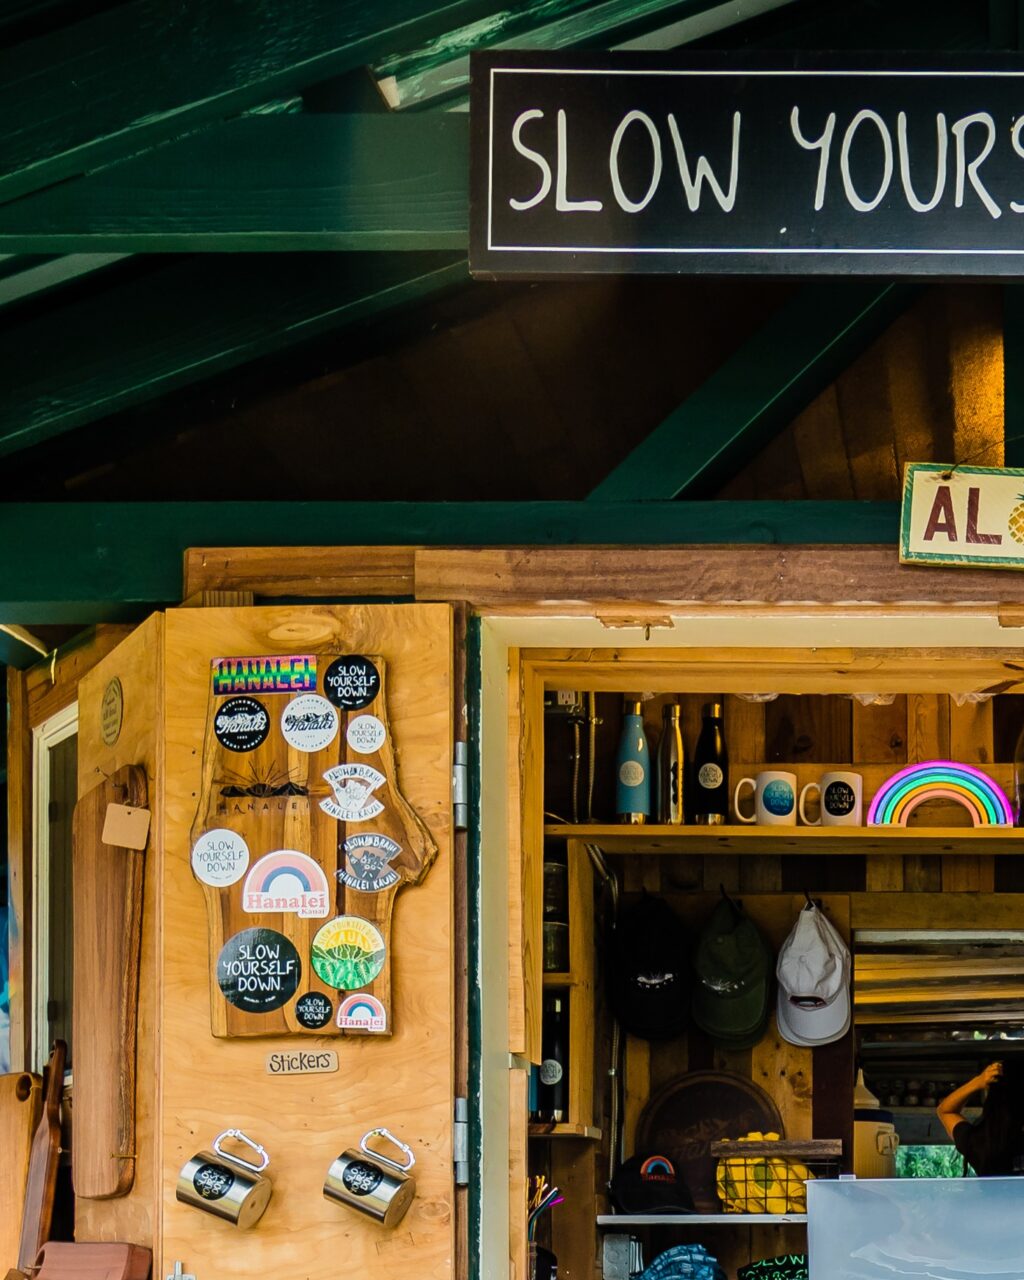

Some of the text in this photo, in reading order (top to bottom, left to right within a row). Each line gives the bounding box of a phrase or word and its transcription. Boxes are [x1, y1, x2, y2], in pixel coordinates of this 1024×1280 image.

[509, 107, 741, 214] SLOW
[338, 665, 366, 676] SLOW
[327, 675, 376, 688] YOURSELF
[357, 722, 377, 730] SLOW
[350, 729, 383, 738] YOURSELF
[207, 841, 235, 851] SLOW
[197, 850, 244, 862] YOURSELF
[206, 862, 236, 873] DOWN
[246, 893, 326, 909] Hanalei
[238, 944, 280, 960] SLOW
[222, 959, 296, 976] YOURSELF
[237, 976, 282, 992] DOWN
[304, 998, 325, 1006] SLOW
[297, 1005, 331, 1014] YOURSELF
[303, 1013, 324, 1021] DOWN
[338, 1017, 384, 1027] Hanalei
[269, 1051, 331, 1073] Stickers
